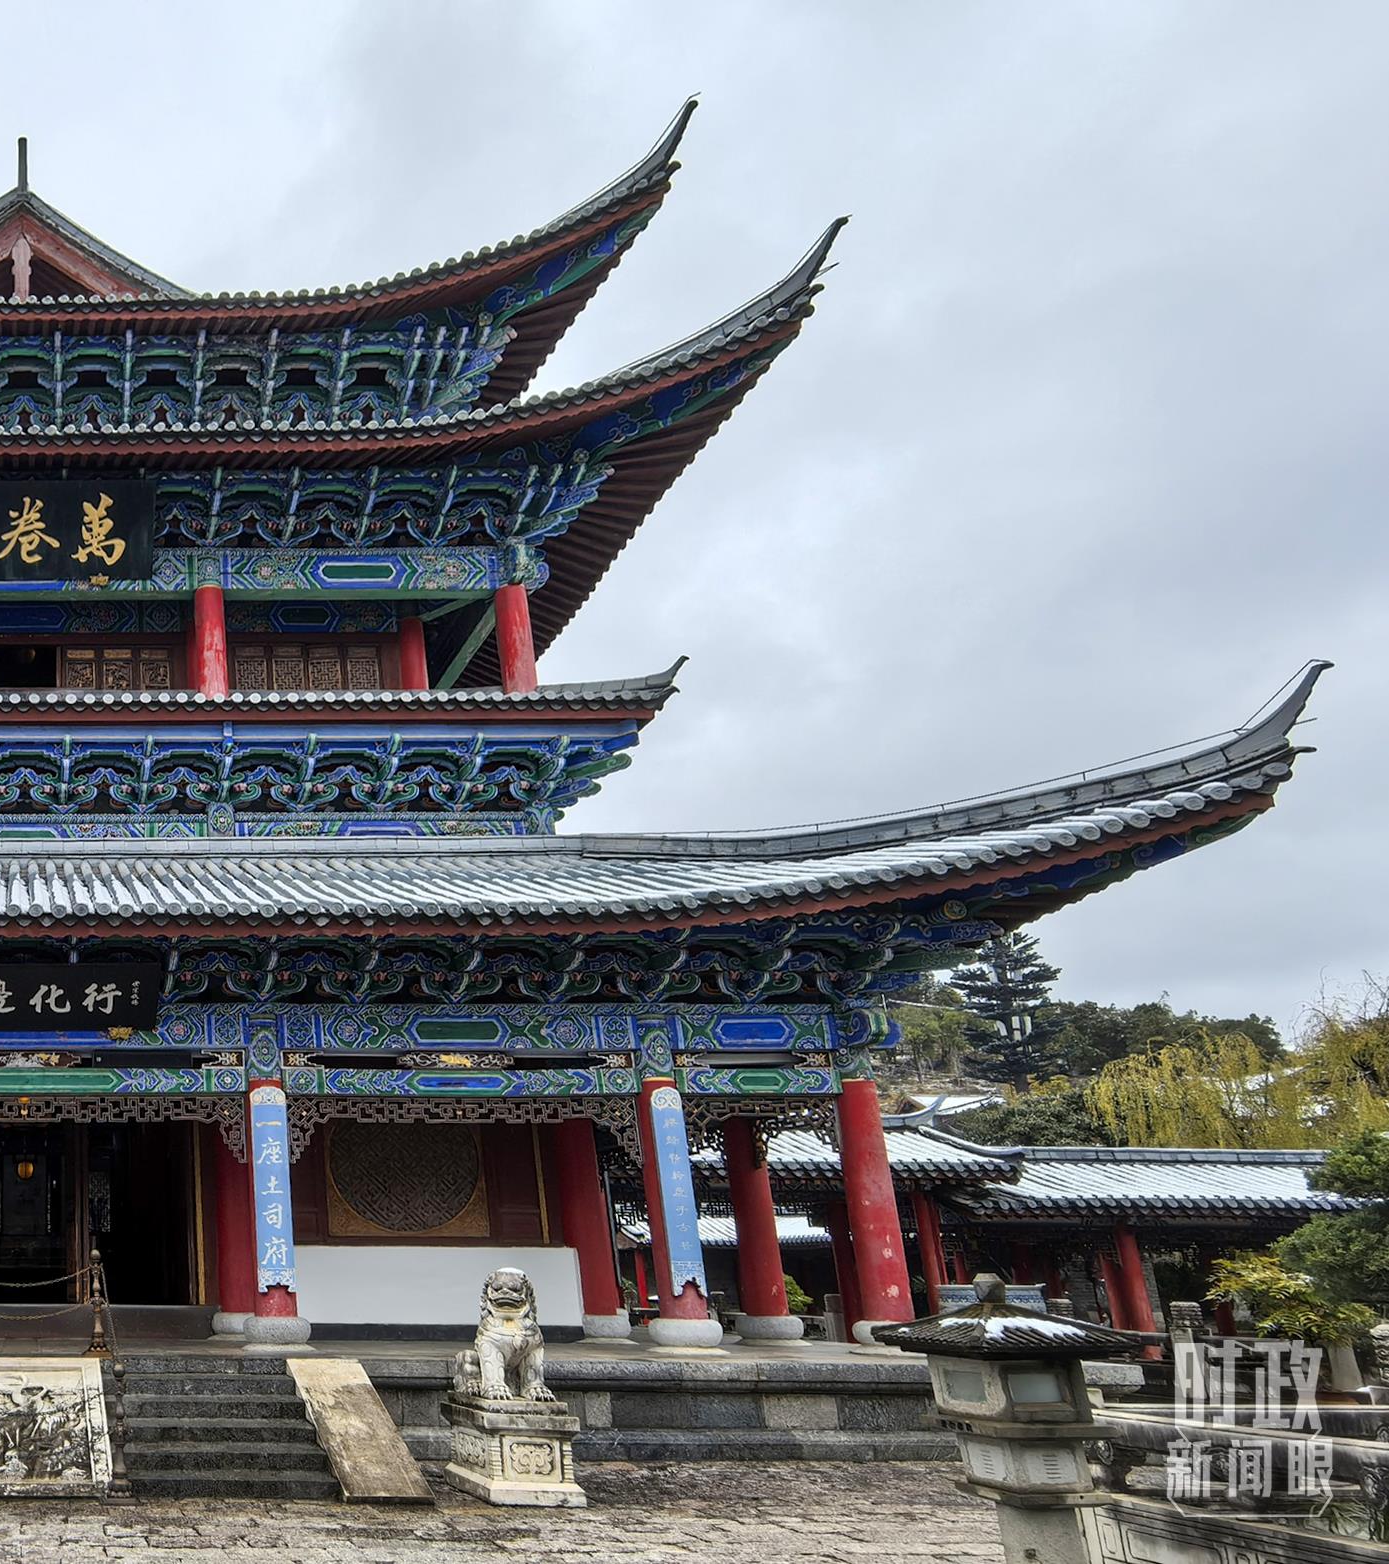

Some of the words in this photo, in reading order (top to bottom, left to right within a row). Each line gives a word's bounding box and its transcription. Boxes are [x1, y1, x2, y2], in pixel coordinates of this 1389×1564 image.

[255, 1119, 288, 1266] 一座土司府
